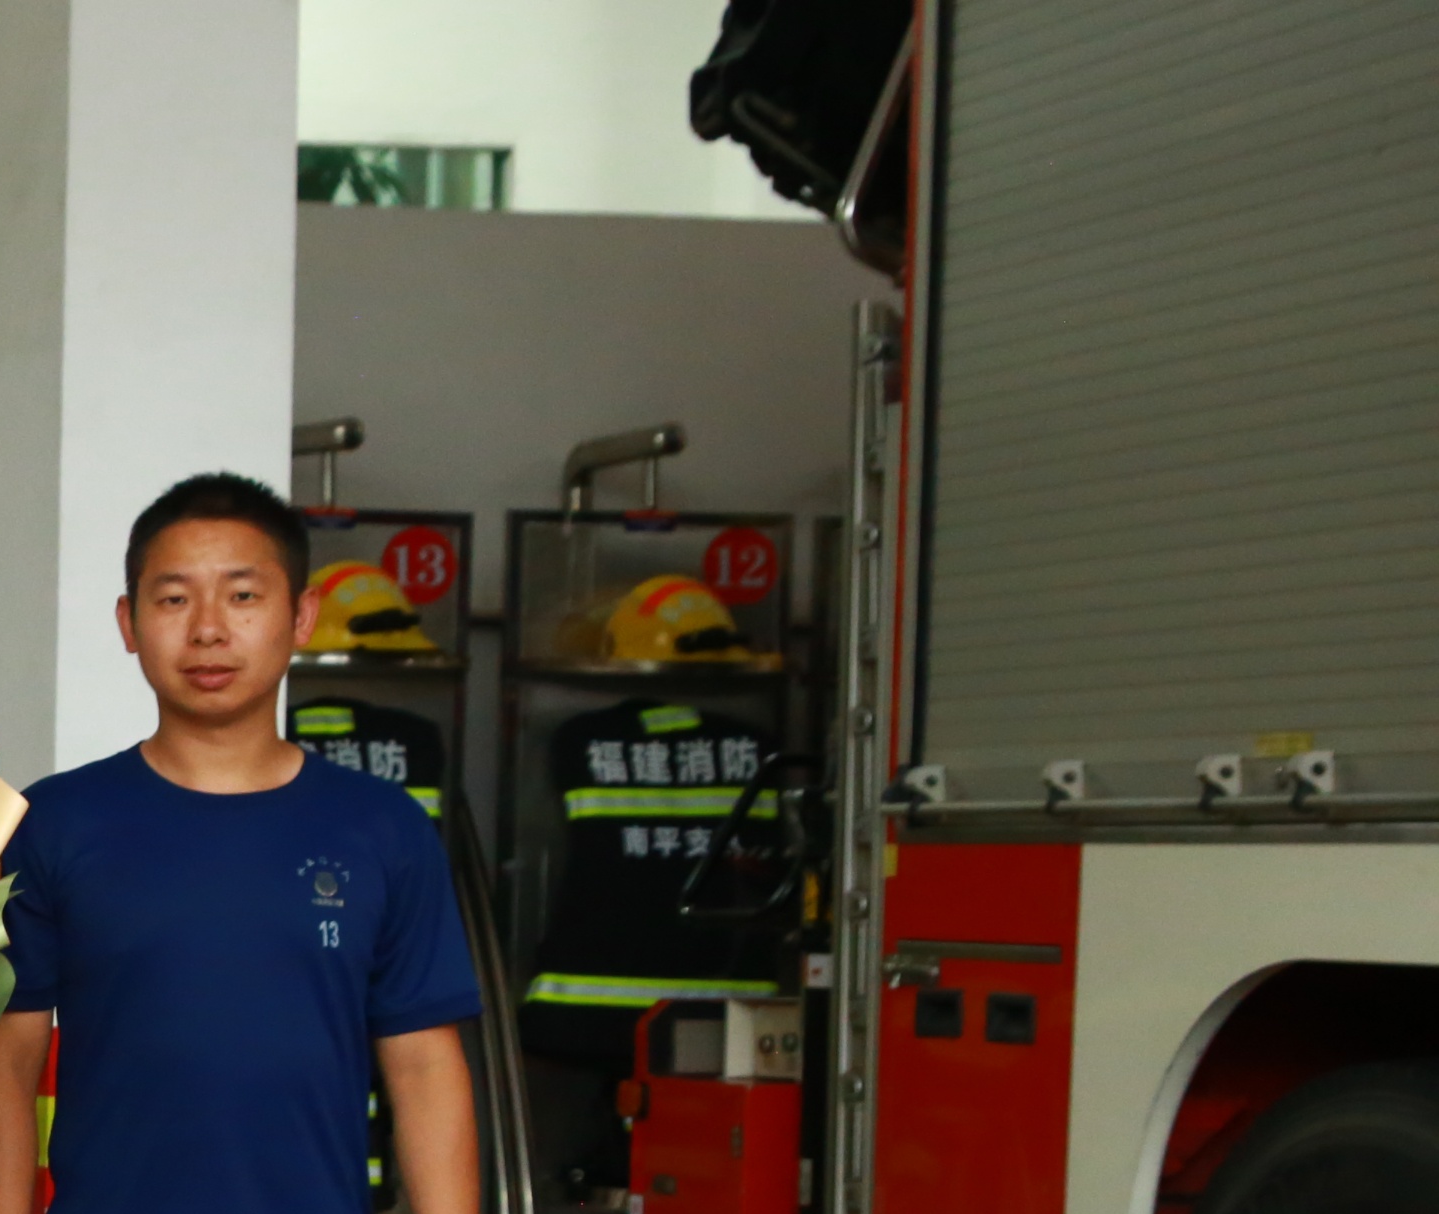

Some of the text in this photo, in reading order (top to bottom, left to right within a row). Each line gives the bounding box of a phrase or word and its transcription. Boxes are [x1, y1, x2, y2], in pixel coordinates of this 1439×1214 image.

[393, 543, 447, 587] 13
[716, 544, 768, 587] 12
[299, 739, 407, 782] 消防
[587, 736, 760, 784] 福建消防
[318, 920, 340, 948] 13
